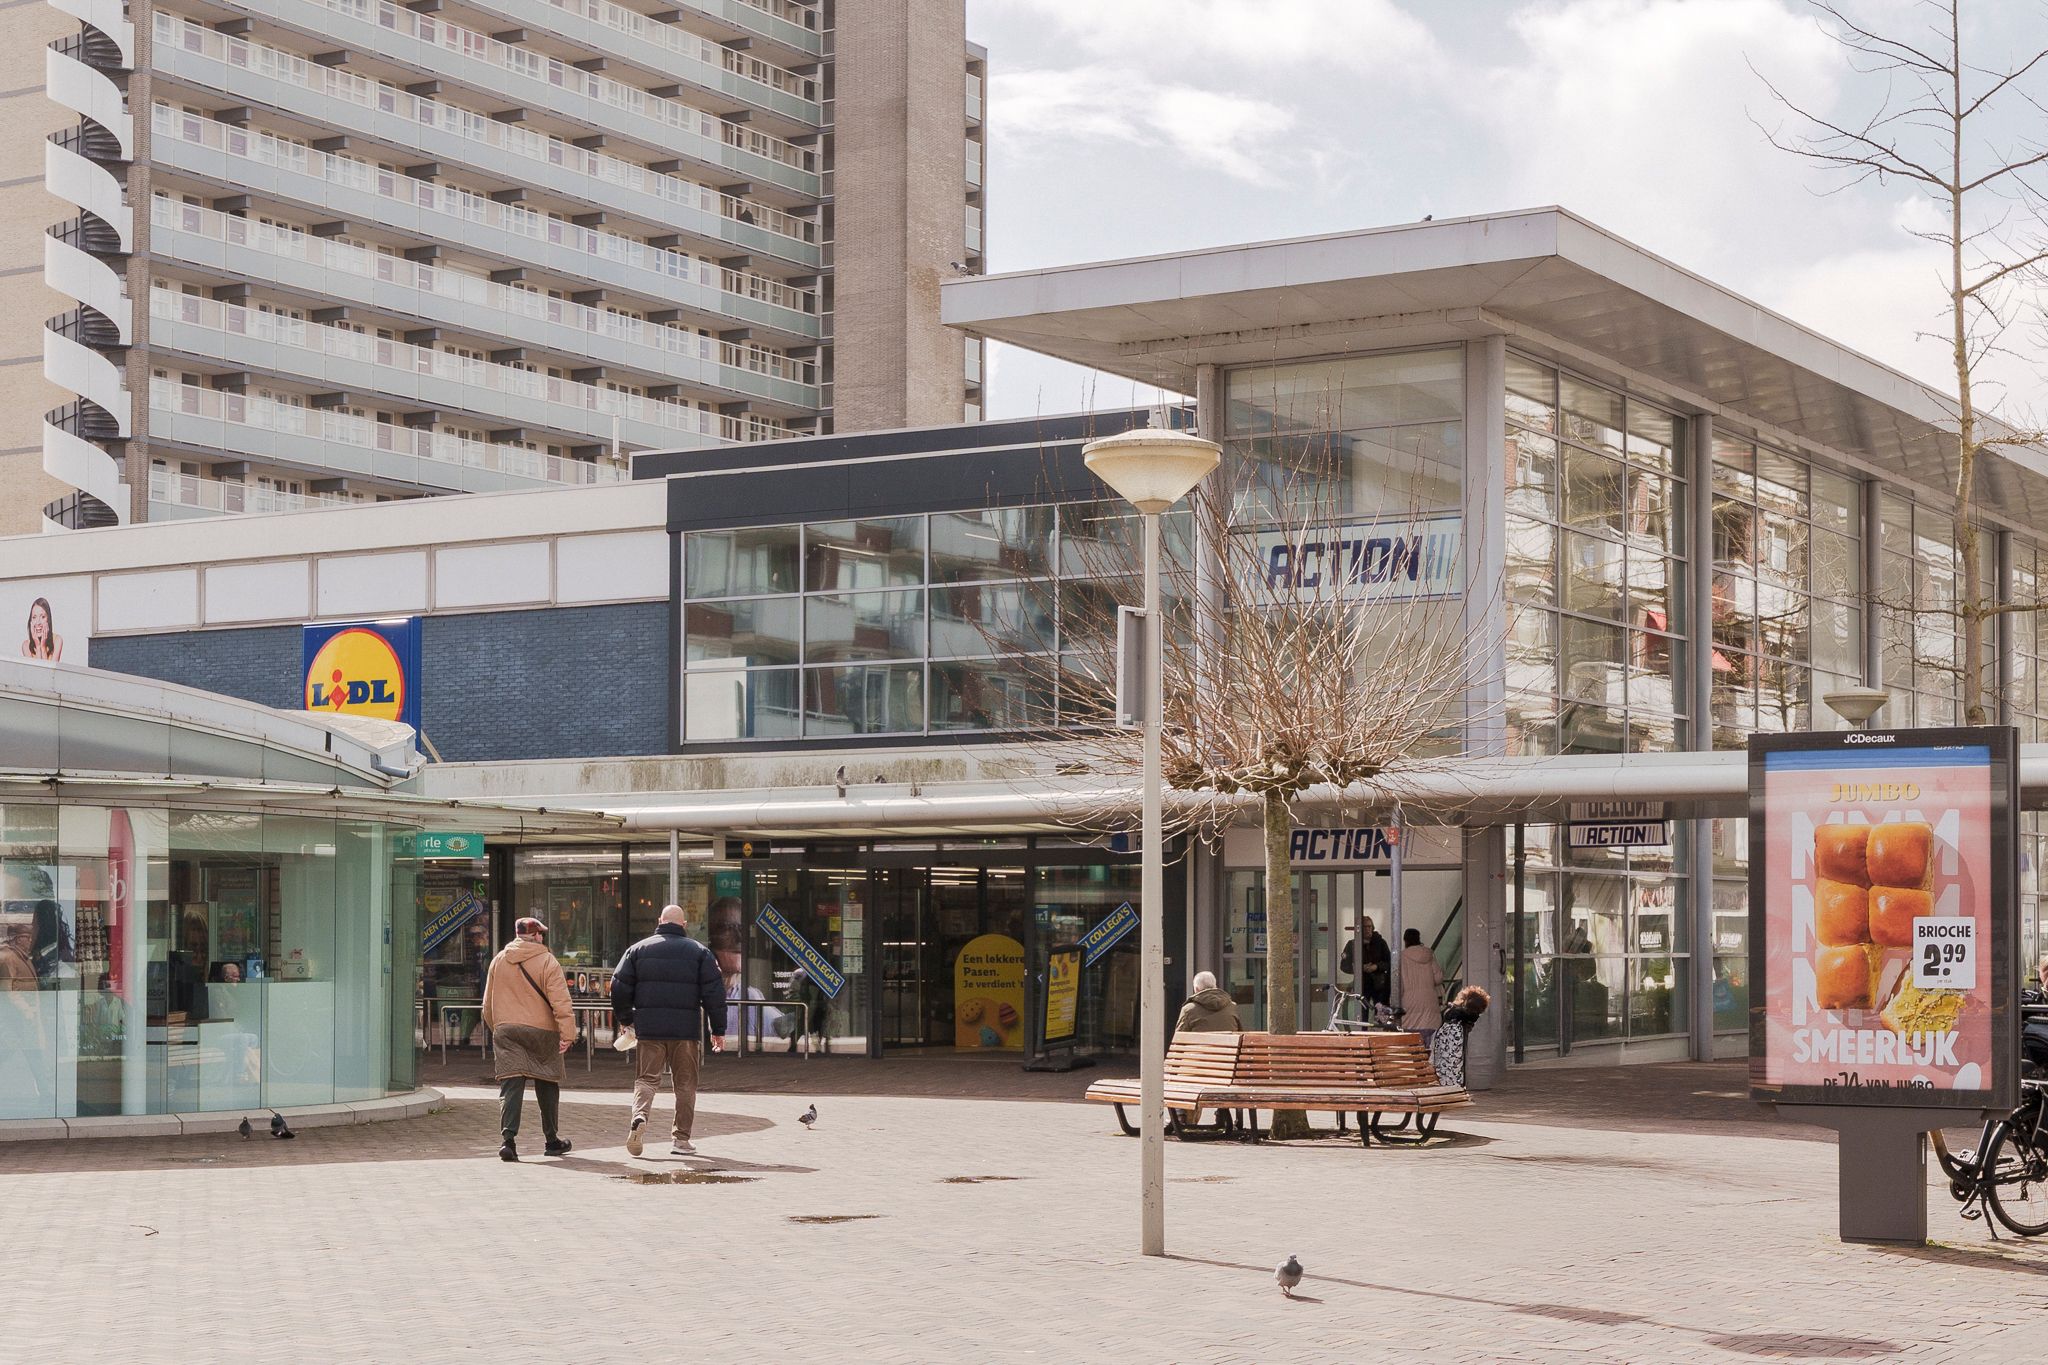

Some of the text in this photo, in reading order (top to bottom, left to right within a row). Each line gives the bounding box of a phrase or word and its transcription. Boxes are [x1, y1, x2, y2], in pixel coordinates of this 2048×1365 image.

[1267, 535, 1423, 590] ACTION
[1843, 734, 1896, 744] JCDecaux
[1828, 783, 1921, 803] JUMBO
[1290, 829, 1391, 861] ACTION
[1586, 826, 1647, 845] ACTION
[1089, 906, 1130, 945] COLLEGA'S
[1918, 926, 1971, 938] BRIOCHE
[765, 908, 780, 925] WIJ
[778, 922, 806, 952] ZOEKEN
[804, 949, 841, 987] COLLEGA'S
[963, 954, 983, 963] Een
[1923, 944, 1966, 976] 2.99
[963, 967, 1000, 976] Pasen.
[963, 980, 974, 988] Je
[976, 980, 1015, 988] verdient
[1792, 1028, 1960, 1066] SMEERLIJK
[1824, 1077, 1838, 1088] DE
[1866, 1079, 1890, 1089] VAN
[1896, 1079, 1935, 1090] JUMBO
